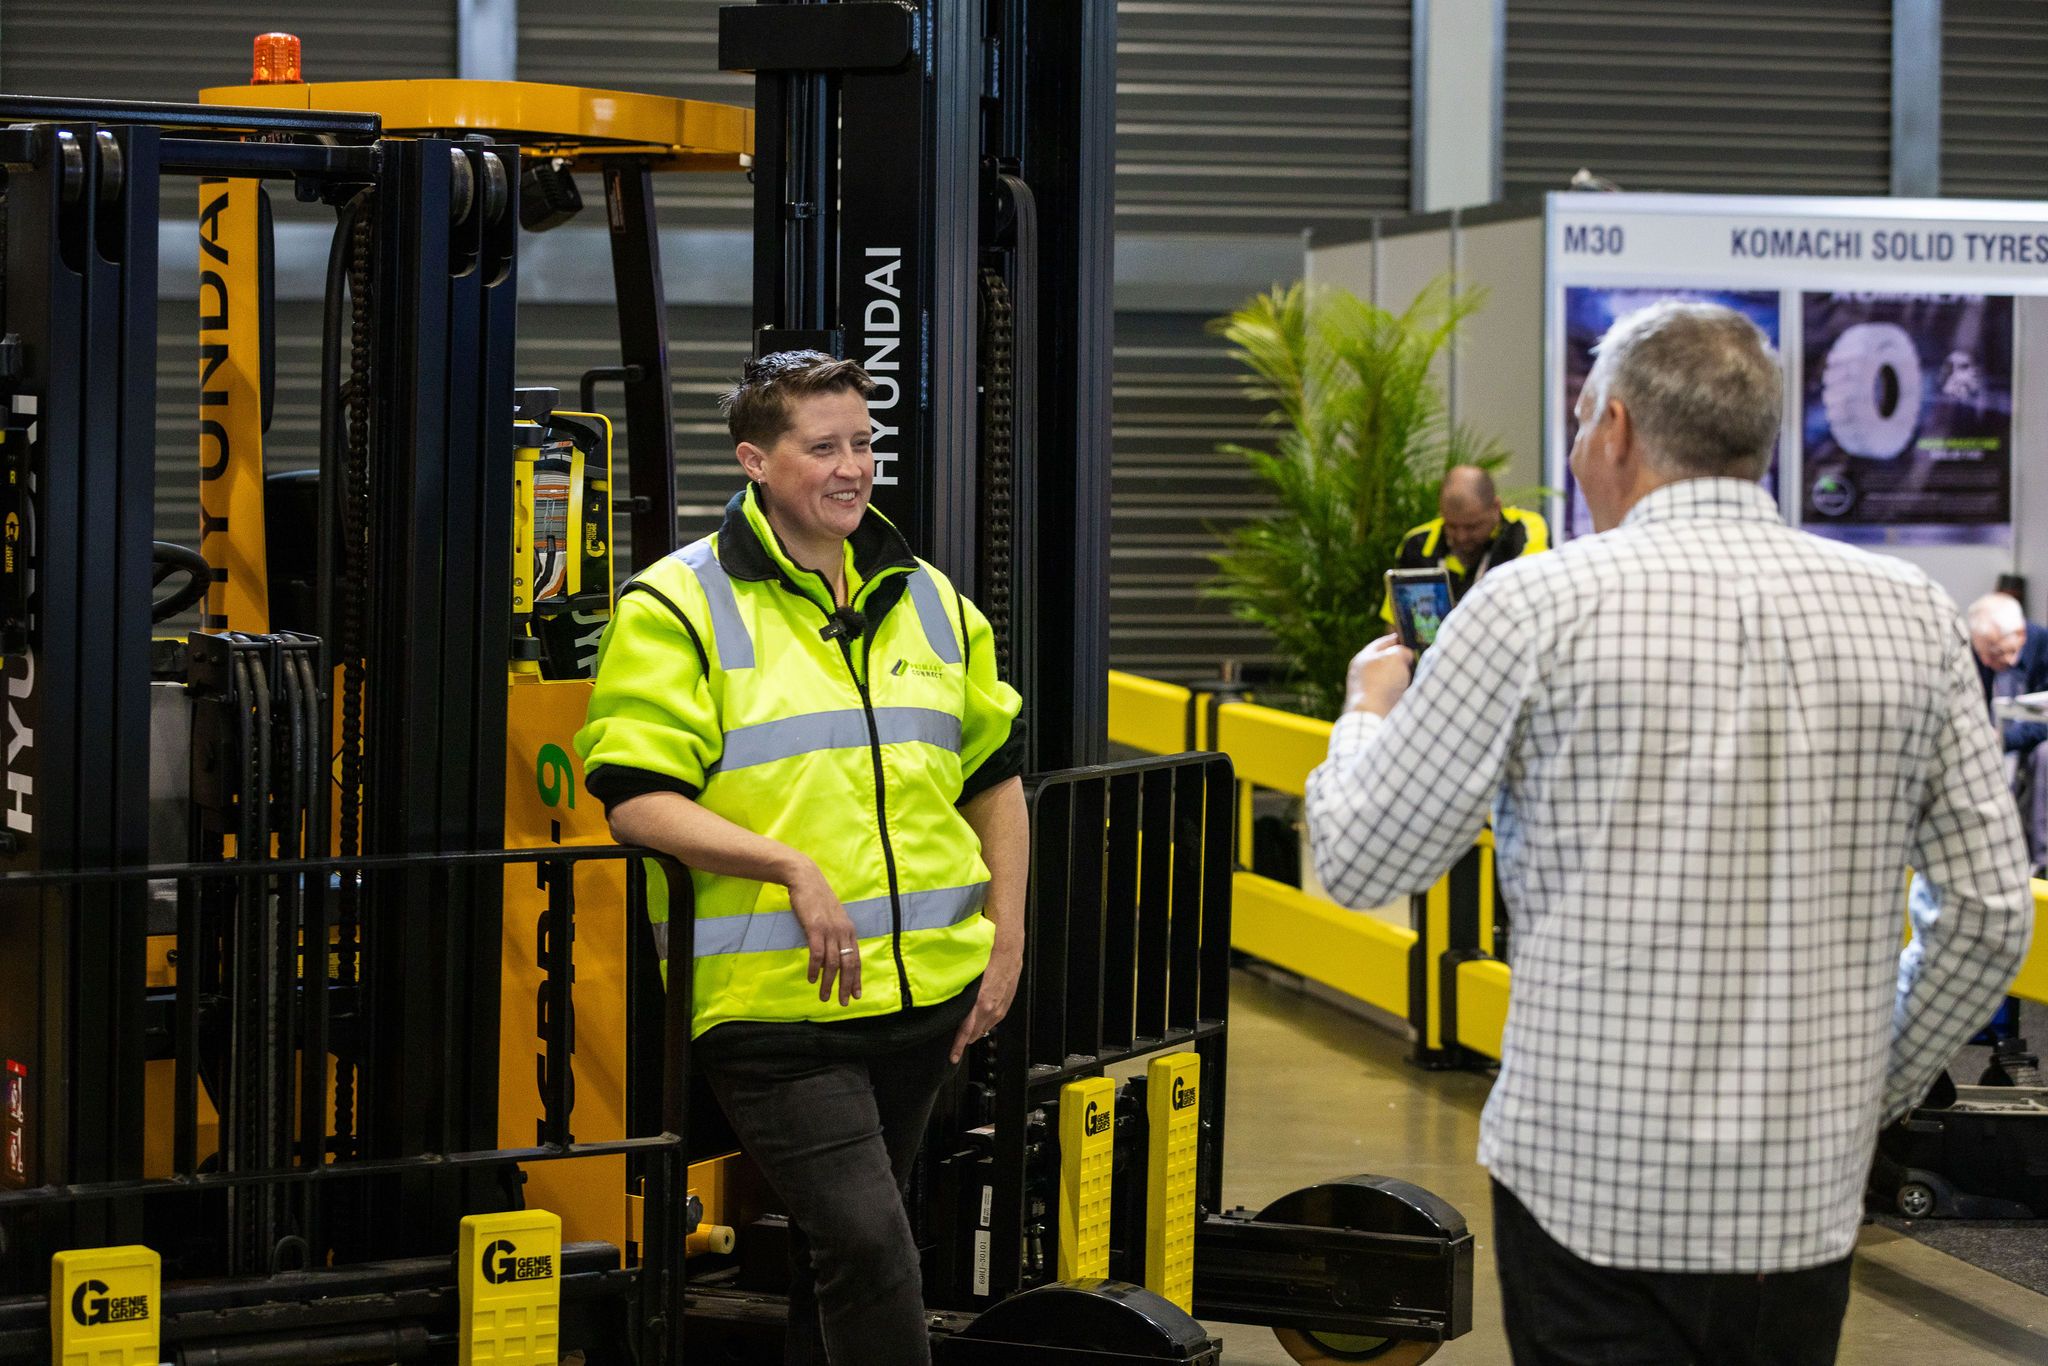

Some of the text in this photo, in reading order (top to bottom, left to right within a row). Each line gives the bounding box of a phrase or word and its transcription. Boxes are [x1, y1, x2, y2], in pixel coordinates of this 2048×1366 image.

[1564, 225, 1624, 255] M30
[1731, 228, 2048, 264] KOMACHI SOLID TYRES
[864, 247, 902, 485] HYUNDAI
[912, 670, 943, 680] CONNECT
[517, 1255, 552, 1268] GENIE
[517, 1266, 552, 1278] GRIPS
[110, 1295, 148, 1309] GENIE
[110, 1306, 149, 1319] GRIPS
